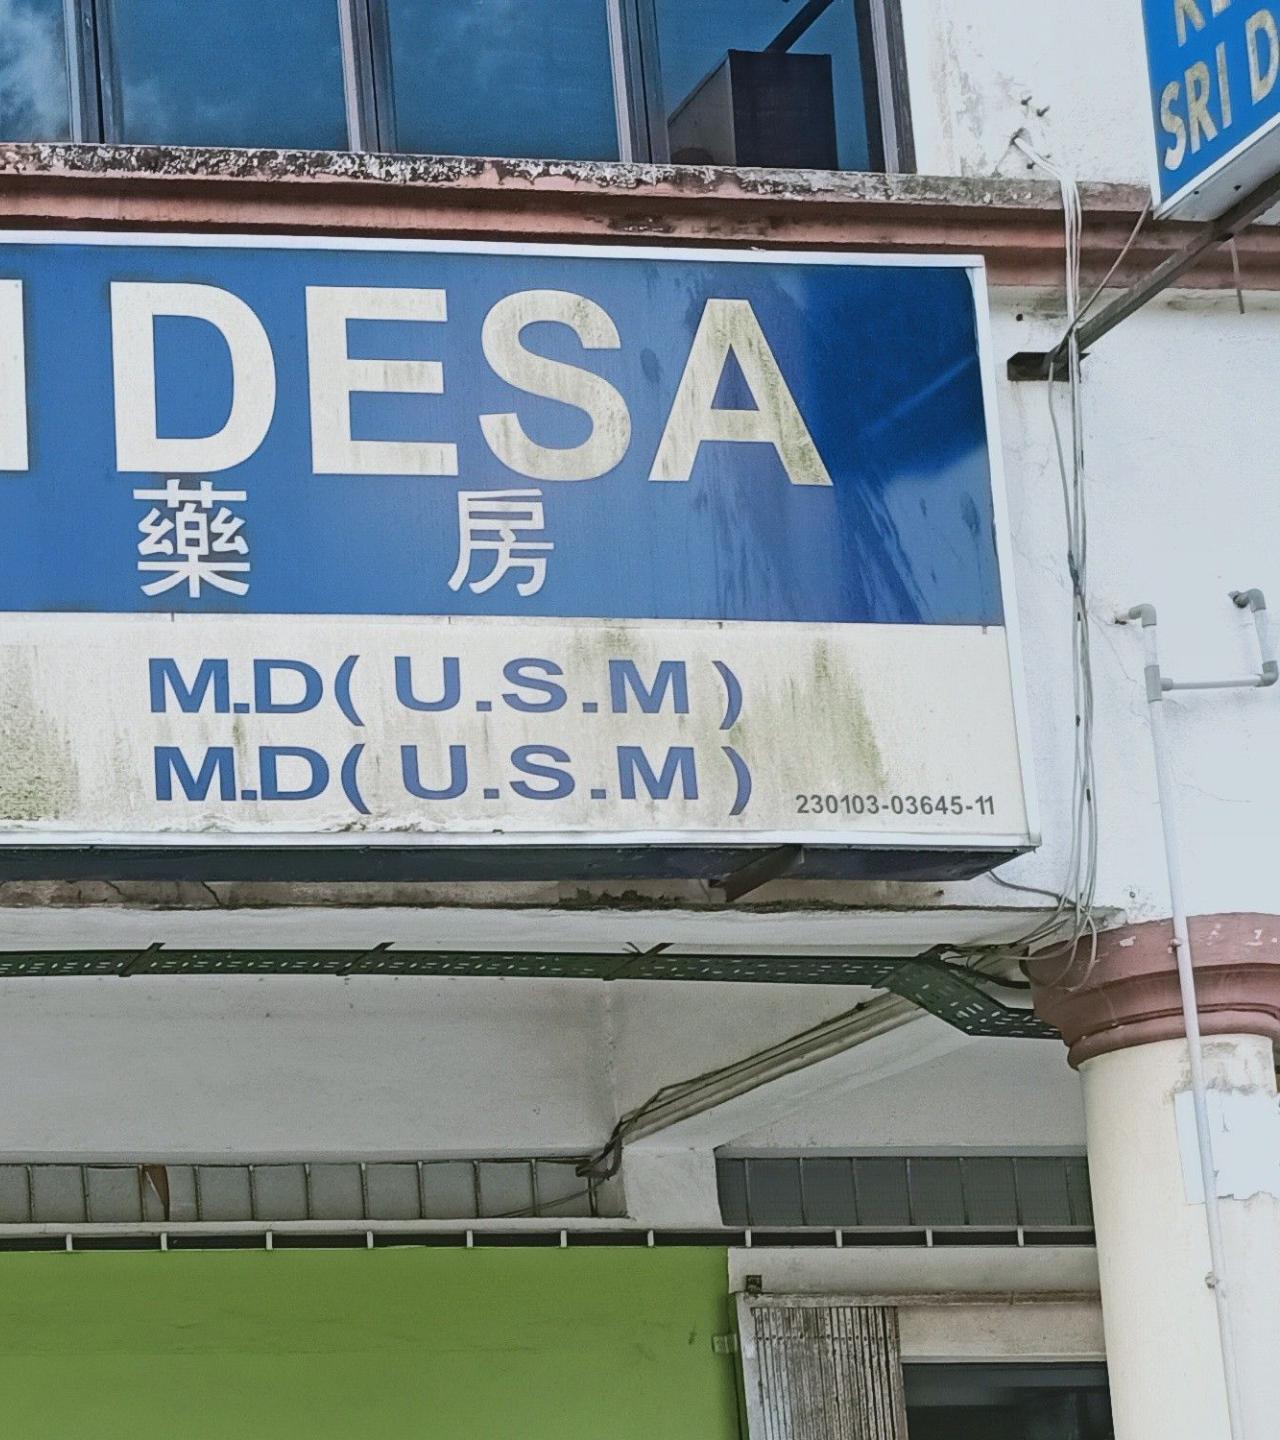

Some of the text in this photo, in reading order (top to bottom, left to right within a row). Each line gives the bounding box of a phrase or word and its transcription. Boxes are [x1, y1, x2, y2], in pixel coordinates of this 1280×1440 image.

[1161, 41, 1232, 171] SRI
[109, 281, 833, 487] DESA
[795, 794, 996, 816] 230103-03645-11
